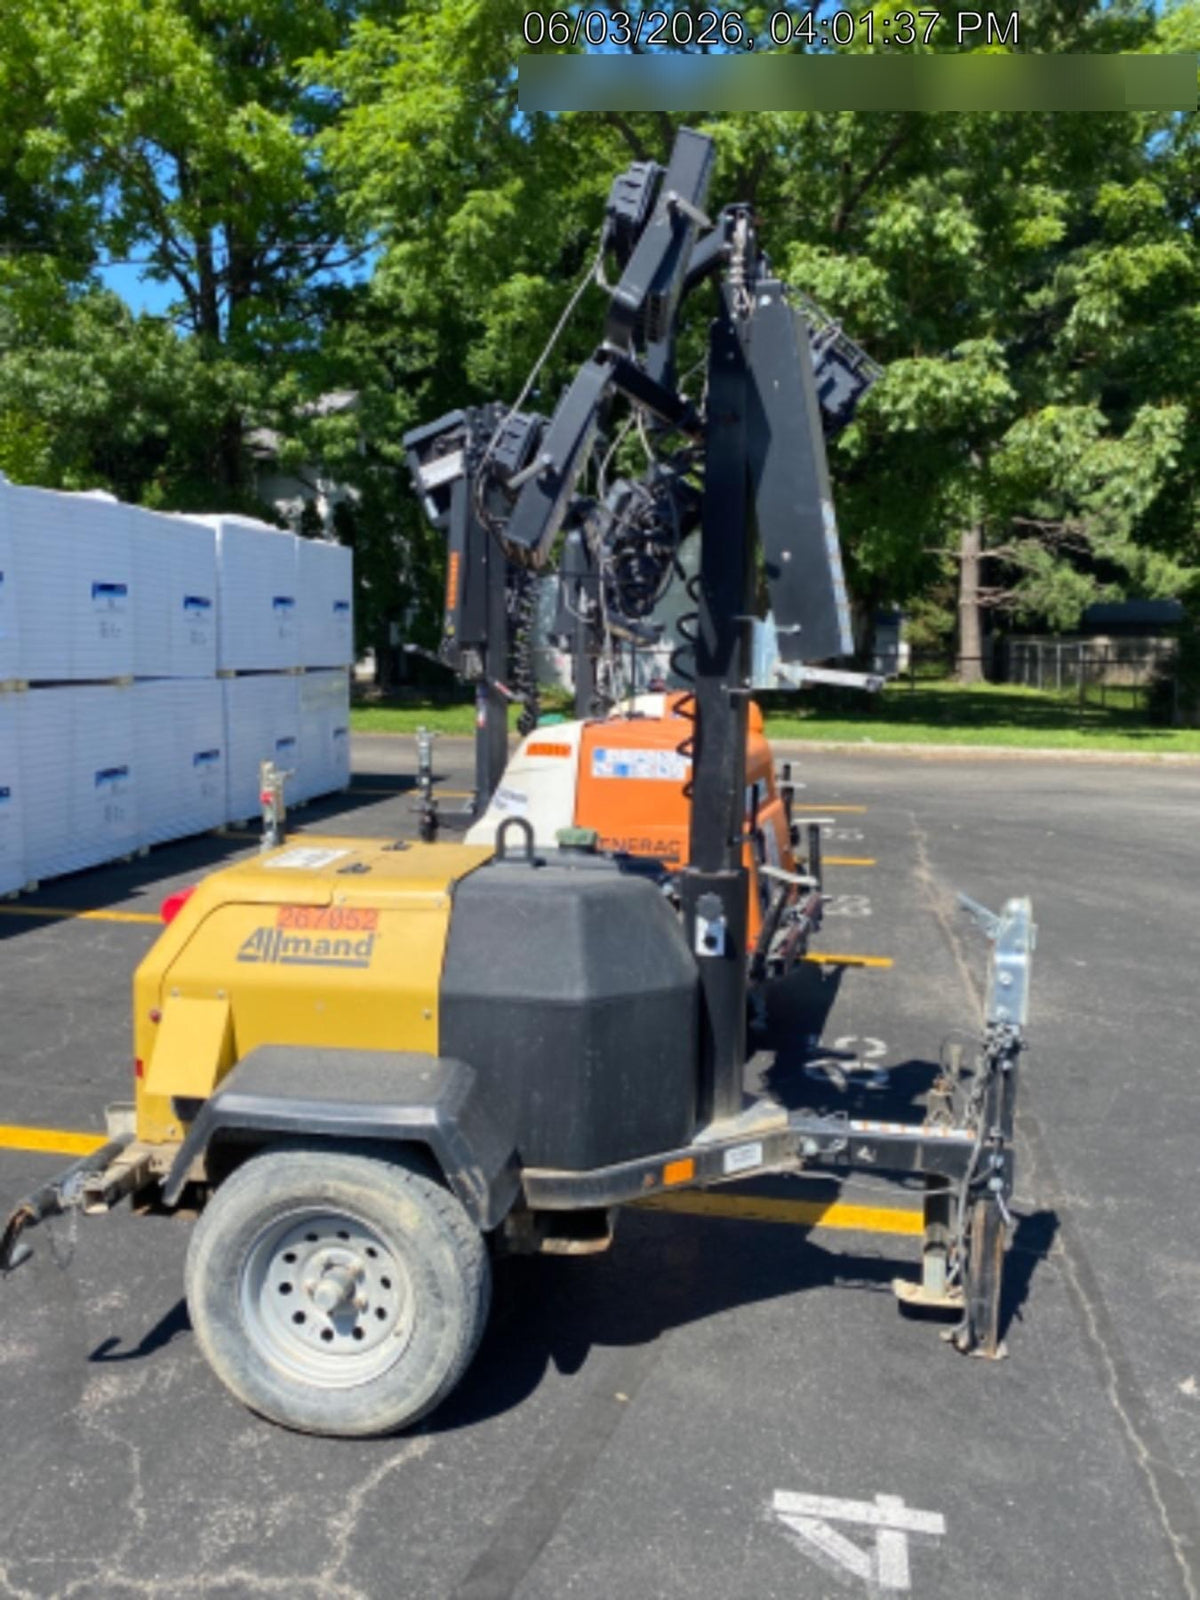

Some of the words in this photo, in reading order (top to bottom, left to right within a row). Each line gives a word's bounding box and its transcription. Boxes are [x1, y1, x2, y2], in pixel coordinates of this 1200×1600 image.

[278, 905, 378, 931] 267052
[237, 926, 378, 967] Allmand
[773, 1489, 946, 1590] 4
